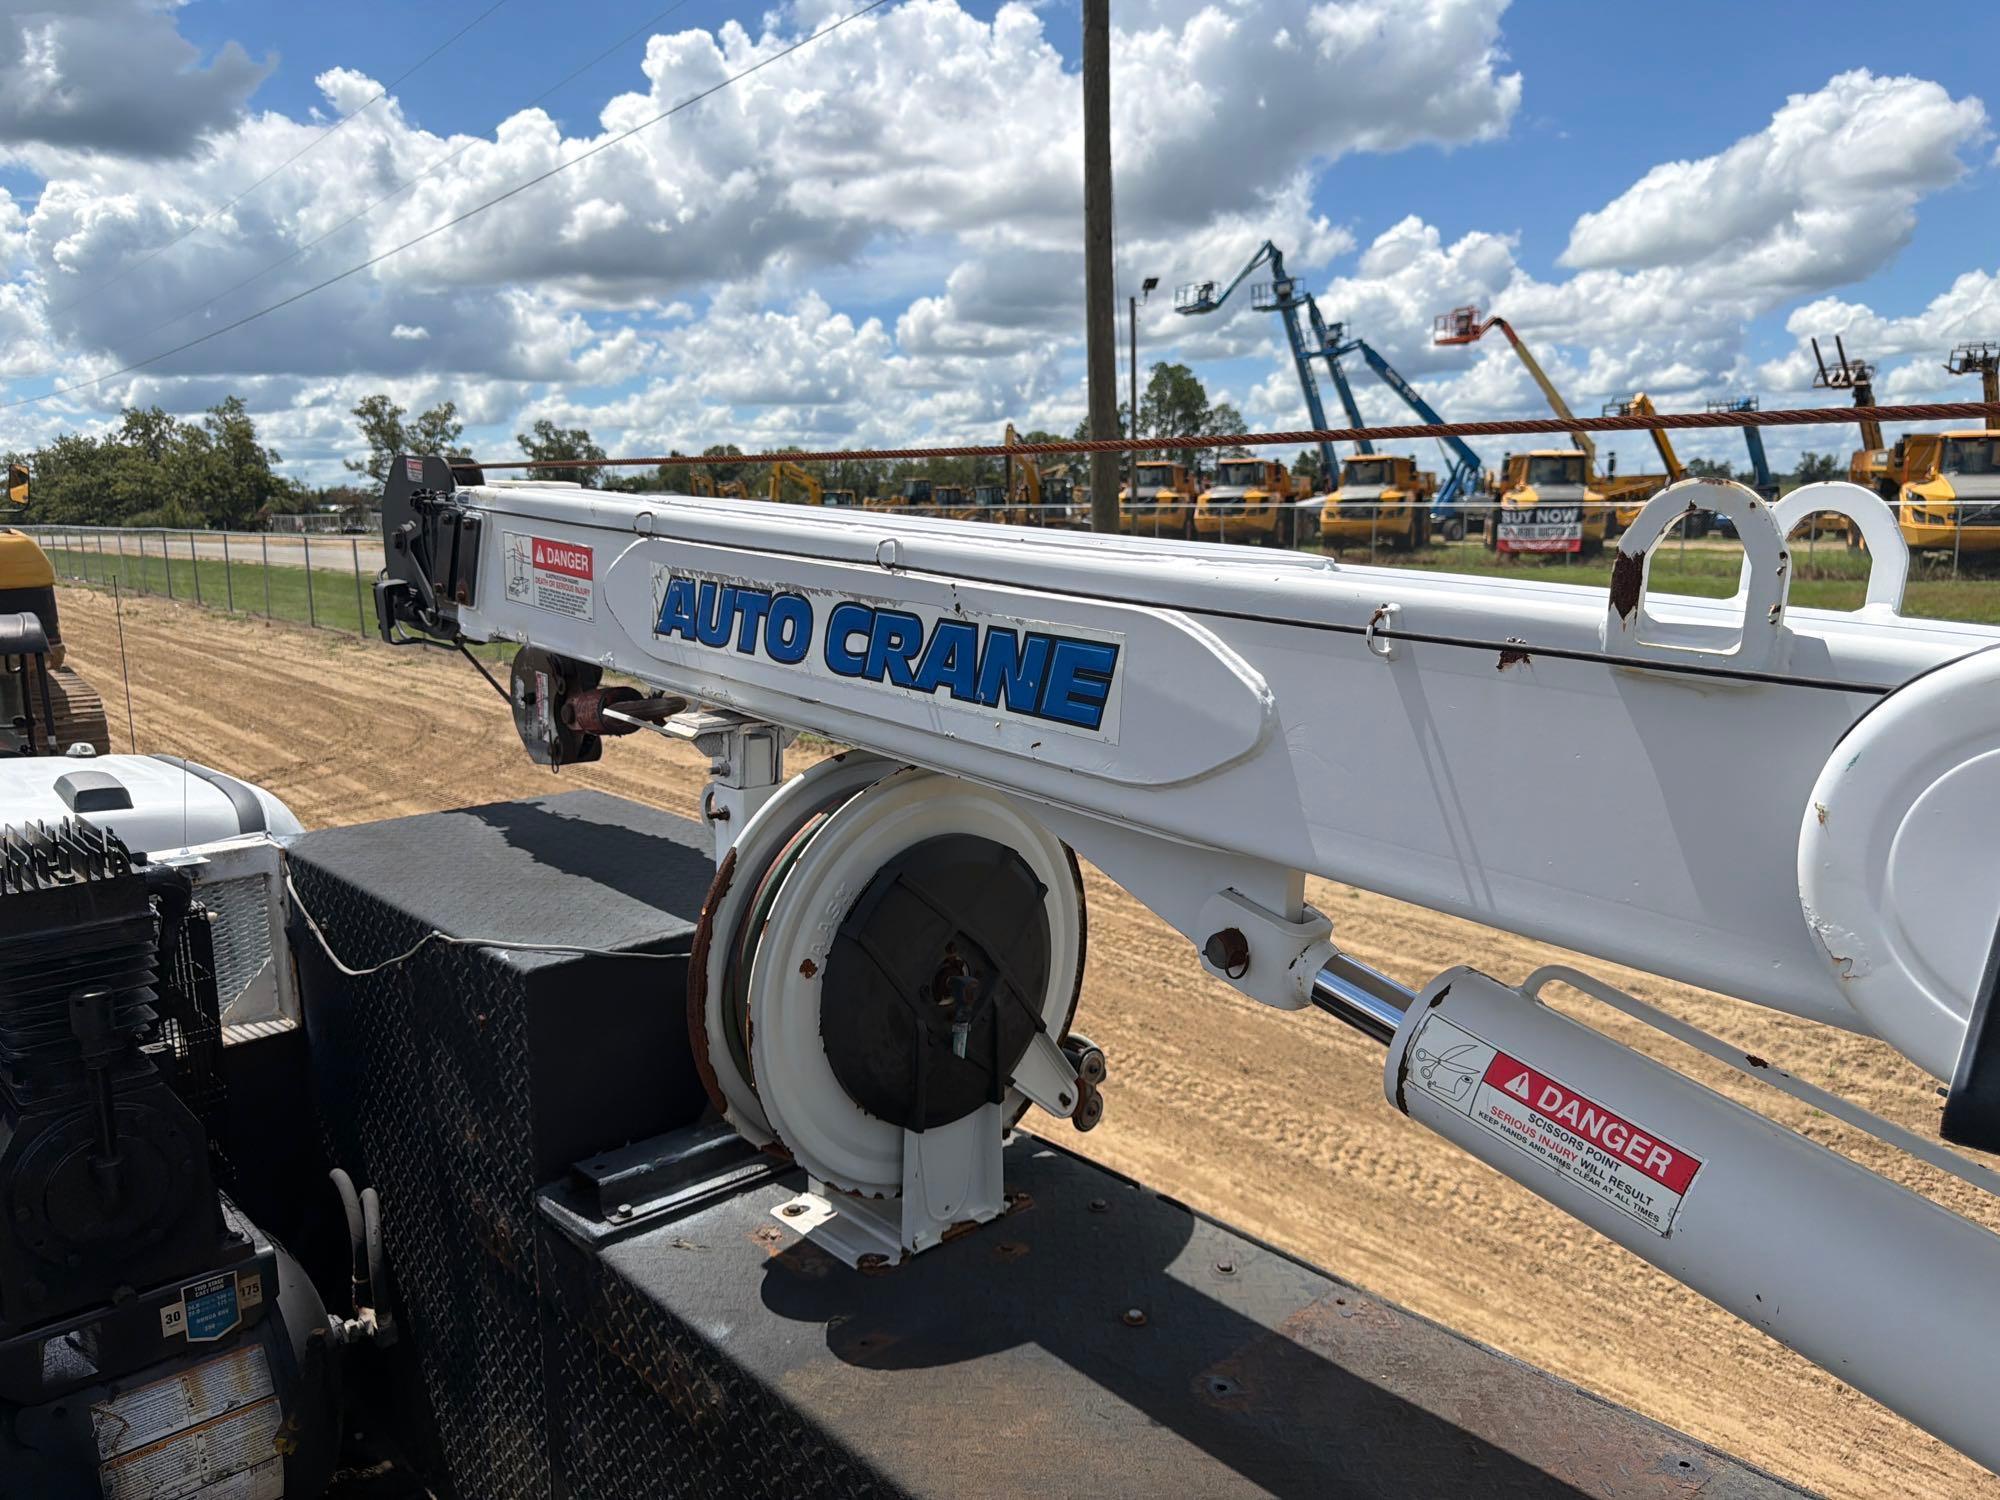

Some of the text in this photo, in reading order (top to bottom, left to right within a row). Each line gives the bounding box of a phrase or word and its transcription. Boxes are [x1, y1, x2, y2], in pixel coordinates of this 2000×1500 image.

[1501, 508, 1579, 524] BUY NOW
[546, 547, 589, 572] DANGER
[655, 575, 1120, 731] AUTO CRANE
[1490, 1105, 1654, 1206] SERIOUS INJURY WILL RESULT
[1528, 1113, 1621, 1172] SCISSORS POINT
[1536, 1085, 1673, 1178] DANGER
[1478, 1110, 1499, 1126] KEEP
[1500, 1123, 1528, 1144] HANDS
[1528, 1141, 1546, 1155] AND
[1547, 1153, 1572, 1170] ARMS
[1573, 1167, 1601, 1187] CLEAR
[1602, 1185, 1614, 1195] AT
[1614, 1193, 1631, 1206] ALL
[1633, 1202, 1660, 1223] TIMES
[164, 1310, 181, 1325] 30
[240, 1284, 260, 1298] 175
